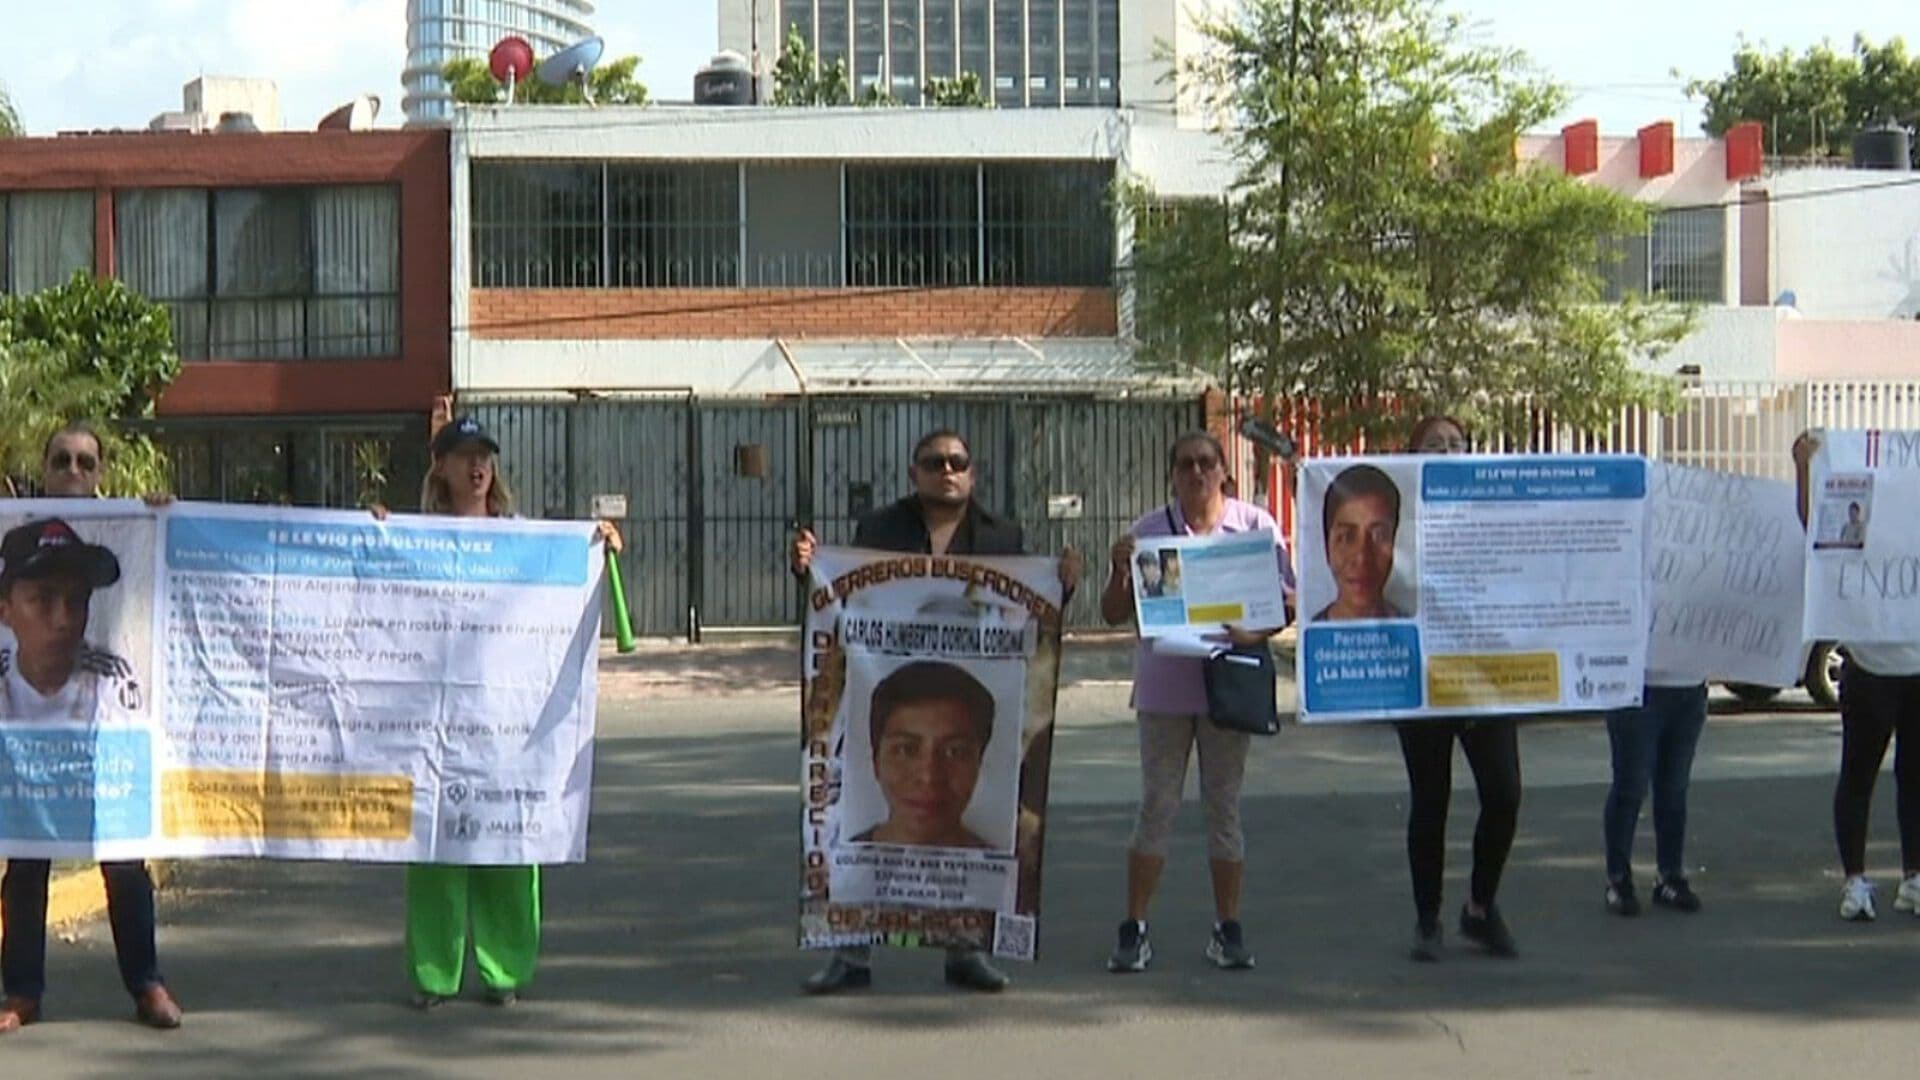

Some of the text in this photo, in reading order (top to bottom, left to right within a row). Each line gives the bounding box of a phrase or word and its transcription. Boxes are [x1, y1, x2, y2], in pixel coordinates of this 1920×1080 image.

[292, 530, 313, 544] LE
[315, 531, 347, 546] VIO
[460, 540, 493, 553] VEZ
[811, 558, 927, 612] GUERREROS
[845, 618, 883, 648] CARLOS
[1333, 632, 1389, 647] Persona
[1315, 645, 1410, 663] desaparecida
[1316, 661, 1410, 684] ¿La has visto?
[16, 780, 59, 800] has
